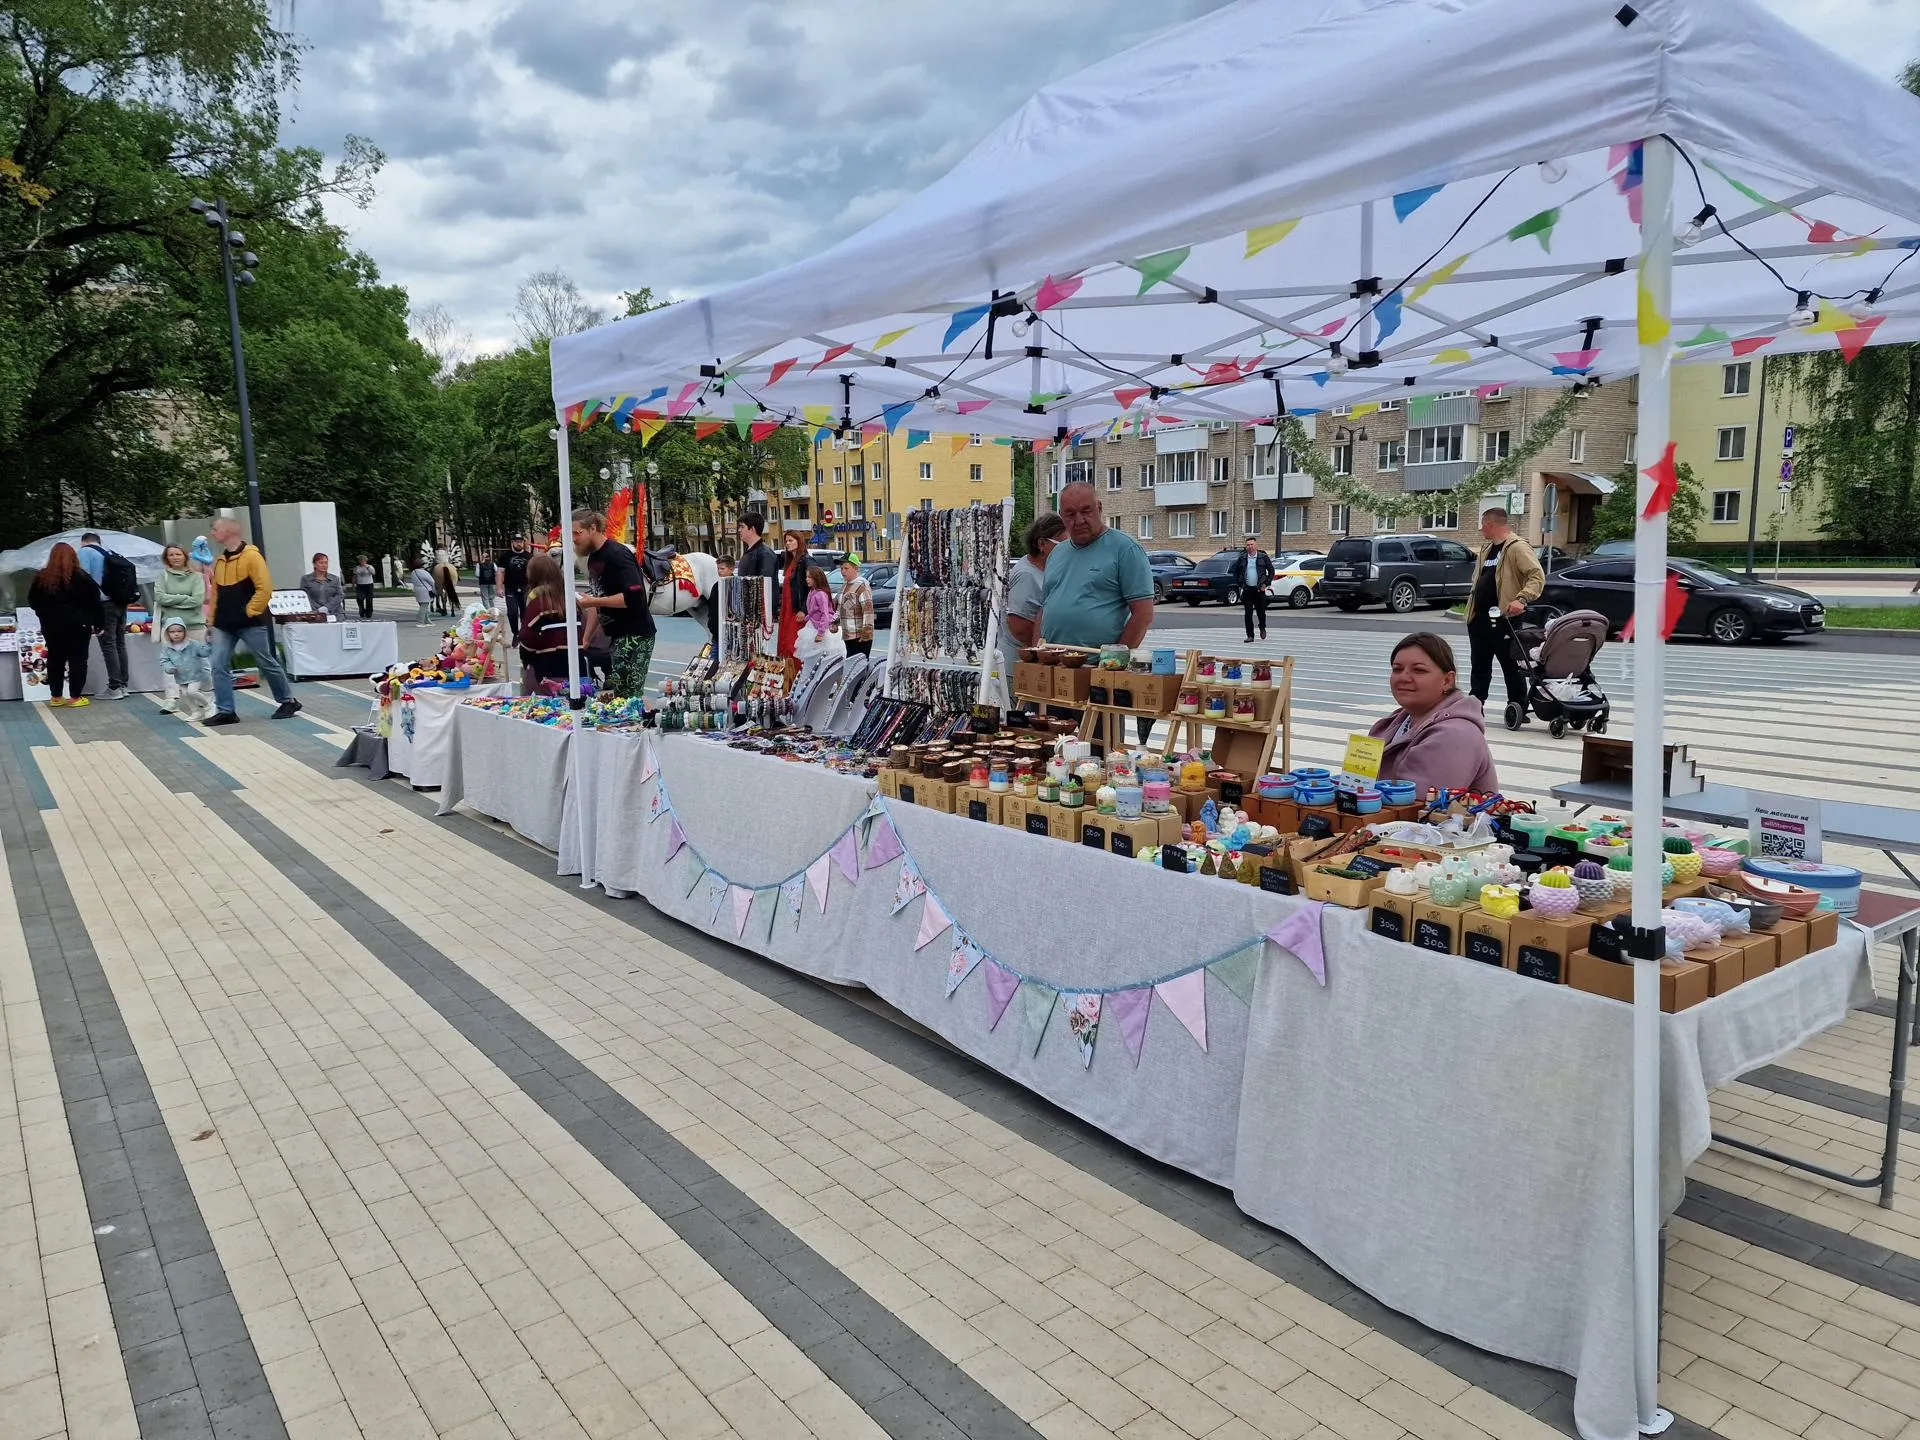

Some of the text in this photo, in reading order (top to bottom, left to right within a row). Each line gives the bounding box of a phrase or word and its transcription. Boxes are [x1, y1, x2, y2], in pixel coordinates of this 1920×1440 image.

[1785, 428, 1792, 447] P
[1770, 811, 1799, 819] магазин
[1763, 820, 1803, 833] wildberries
